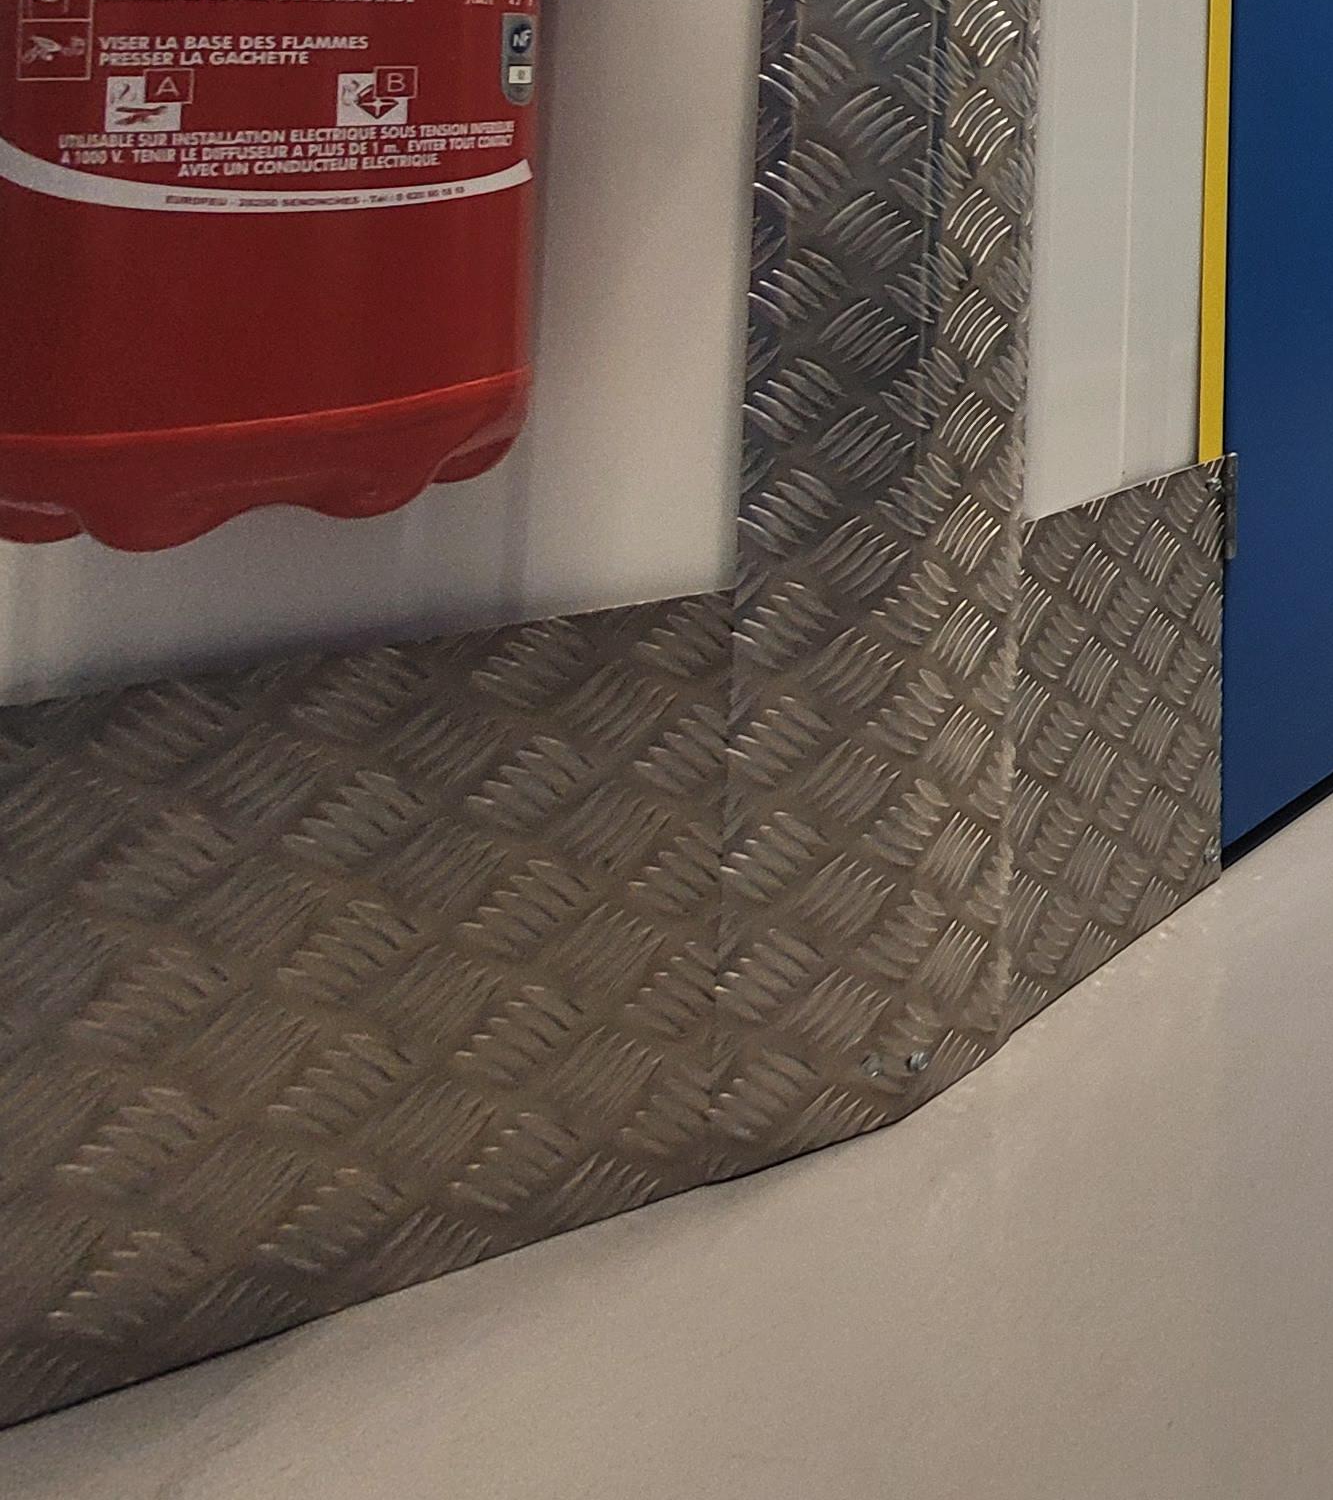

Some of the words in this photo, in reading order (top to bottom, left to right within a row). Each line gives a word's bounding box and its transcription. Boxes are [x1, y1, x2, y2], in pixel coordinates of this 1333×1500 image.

[100, 36, 150, 50] VISER
[155, 36, 179, 50] LA
[184, 36, 233, 50] BASE
[239, 36, 276, 50] DES
[282, 36, 369, 50] FLAMMES
[100, 52, 174, 67] PRESSER
[180, 52, 203, 66] LA
[209, 51, 309, 66] GACHETTE
[155, 76, 180, 97] A
[386, 72, 406, 93] B
[138, 132, 168, 147] SUR
[172, 129, 286, 146] INSTALLATION
[290, 126, 378, 143] ELECTRIQUE
[380, 124, 417, 139] SOUS
[419, 122, 469, 138] TENSION
[132, 148, 176, 163] TENIR
[180, 147, 197, 162] LE
[202, 145, 288, 161] DIFFUSEUR
[291, 144, 303, 157] A
[307, 142, 345, 157] PLUS
[347, 141, 368, 155] DE
[372, 141, 379, 154] 1
[408, 137, 447, 152] EVITER
[449, 136, 476, 150] TOUT
[177, 163, 219, 178] AVEC
[223, 162, 250, 176] UN
[253, 157, 358, 175] CONDUCTEUR
